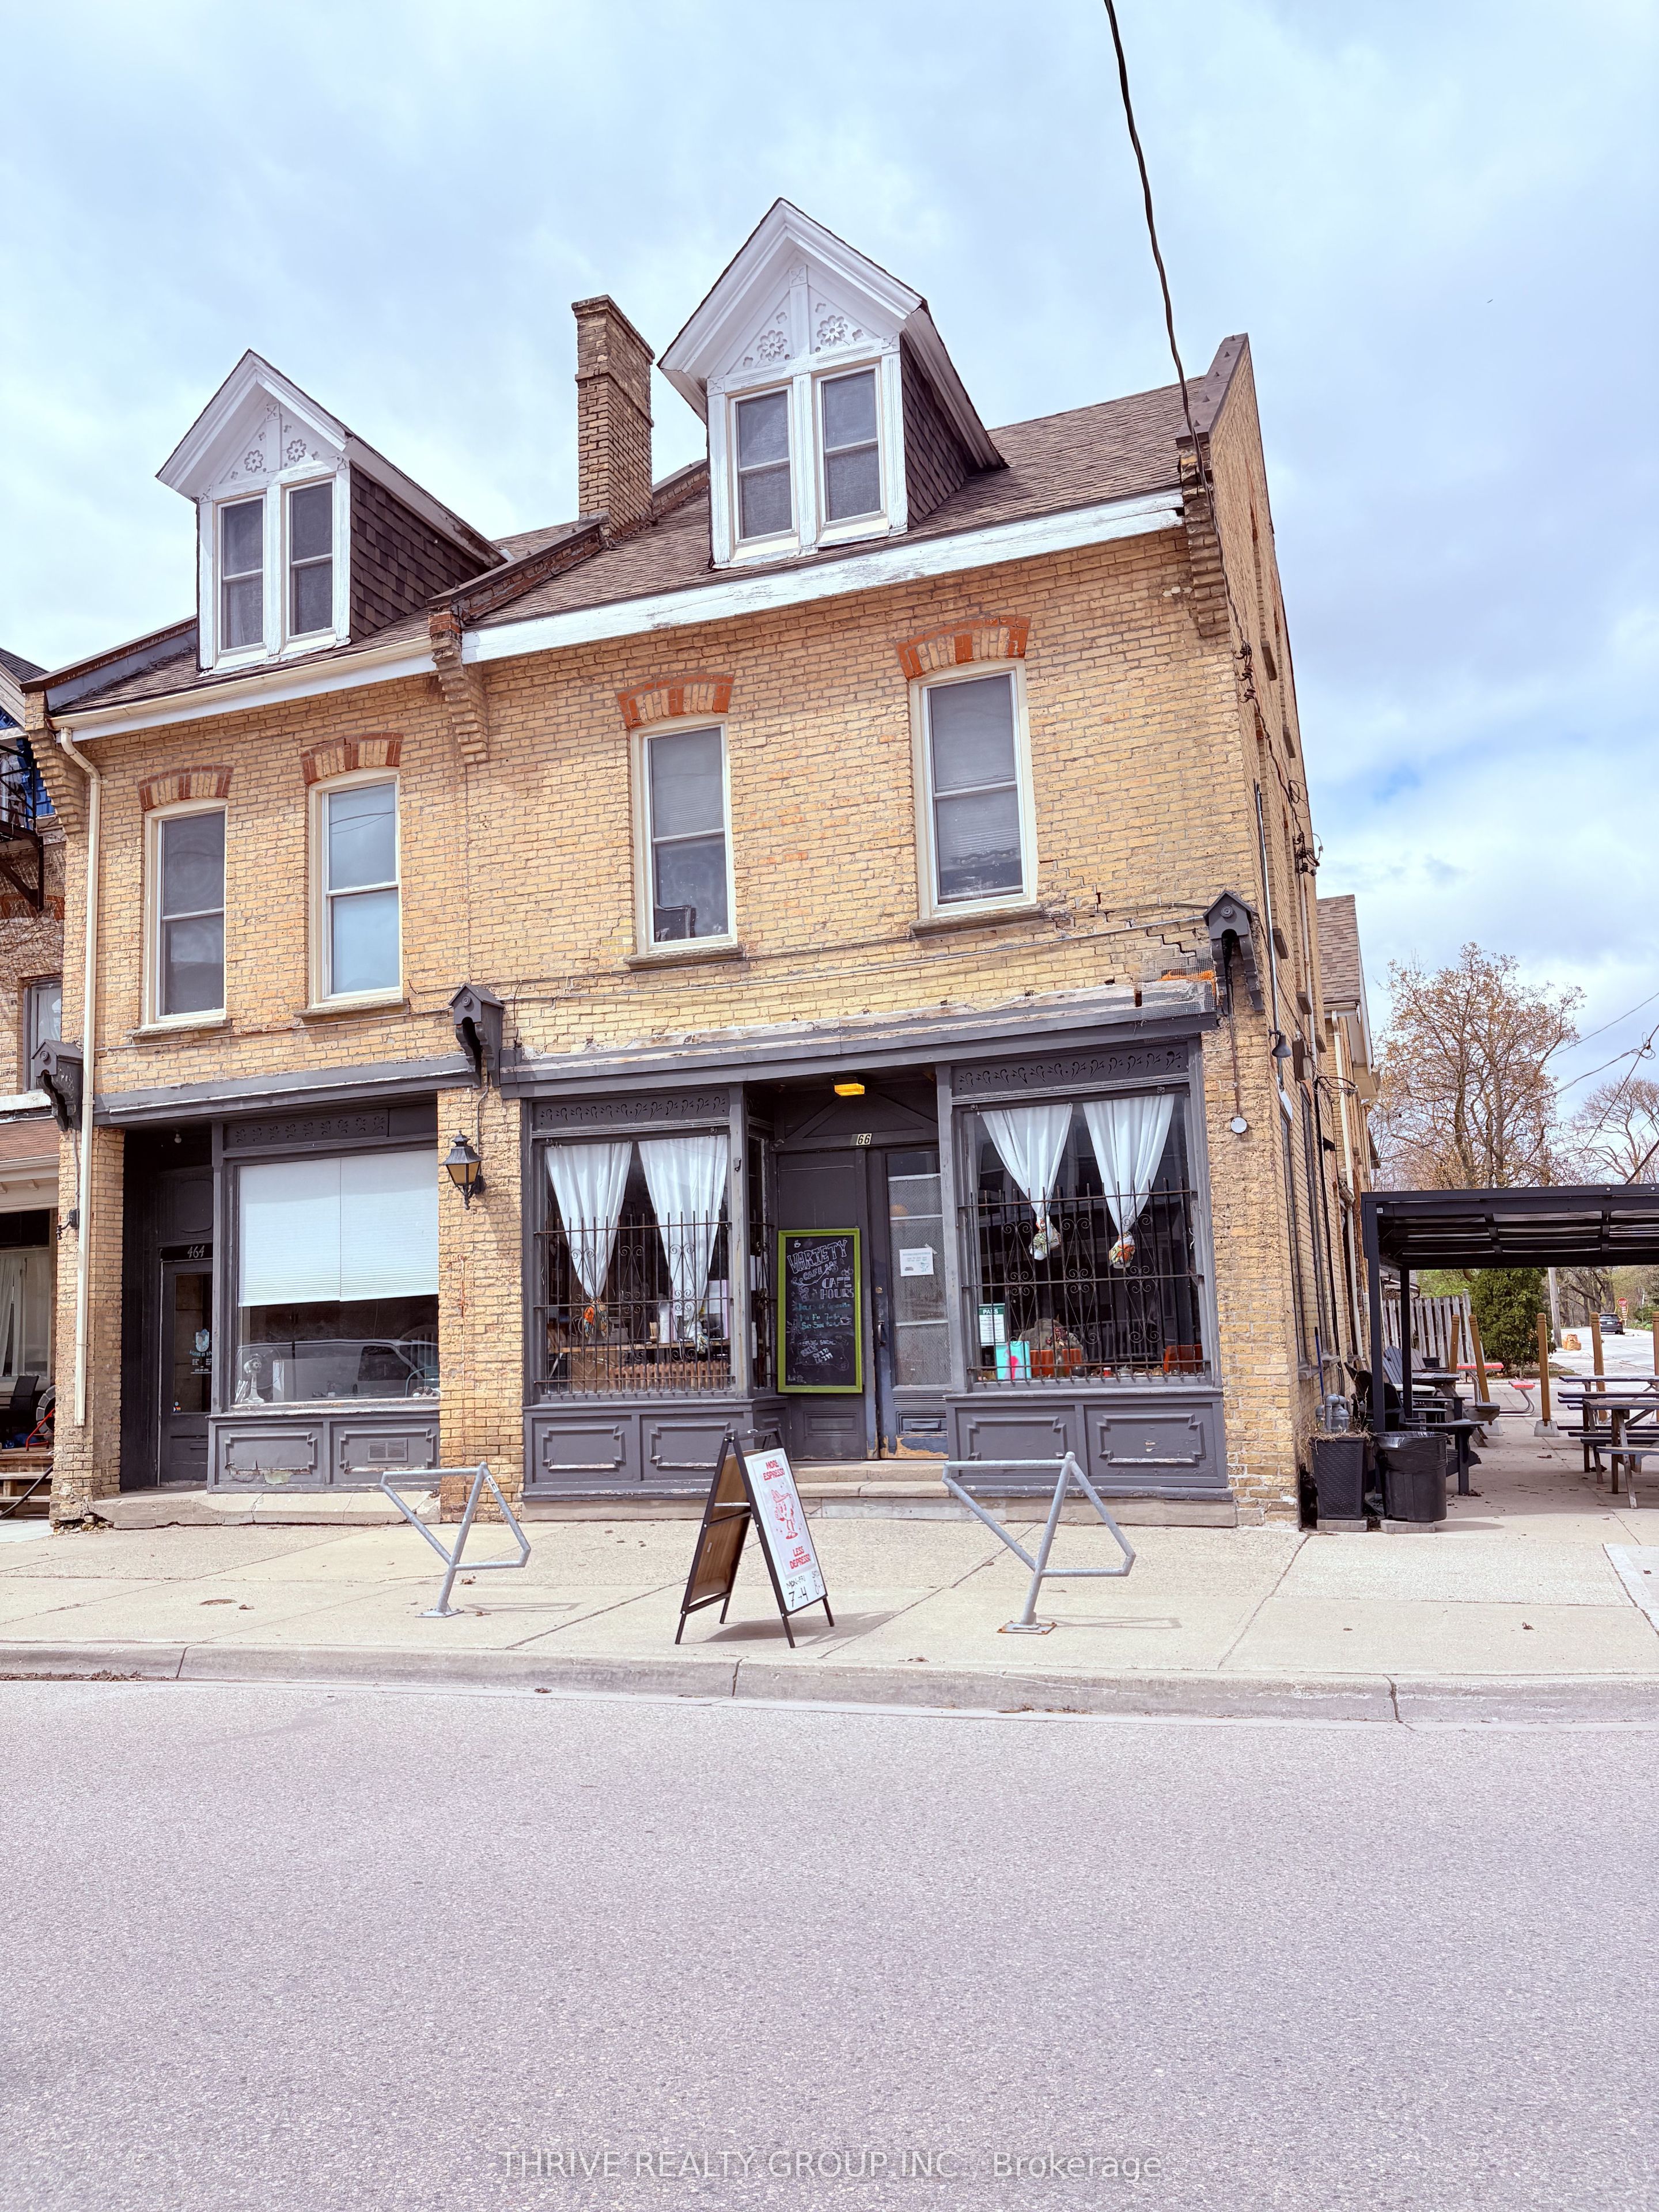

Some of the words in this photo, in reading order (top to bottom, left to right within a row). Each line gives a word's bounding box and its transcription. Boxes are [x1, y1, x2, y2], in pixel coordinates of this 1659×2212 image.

[858, 1134, 871, 1145] 66
[187, 1245, 205, 1259] 464
[787, 1240, 848, 1274] VARIETY
[803, 1266, 823, 1281] CAFE
[821, 1277, 852, 1289] CAFE
[820, 1288, 854, 1300] HOURS
[766, 1460, 779, 1469] MORE
[763, 1468, 785, 1480] ESPRESSO
[793, 1546, 804, 1557] LESS
[789, 1554, 811, 1569] DEPRESSO
